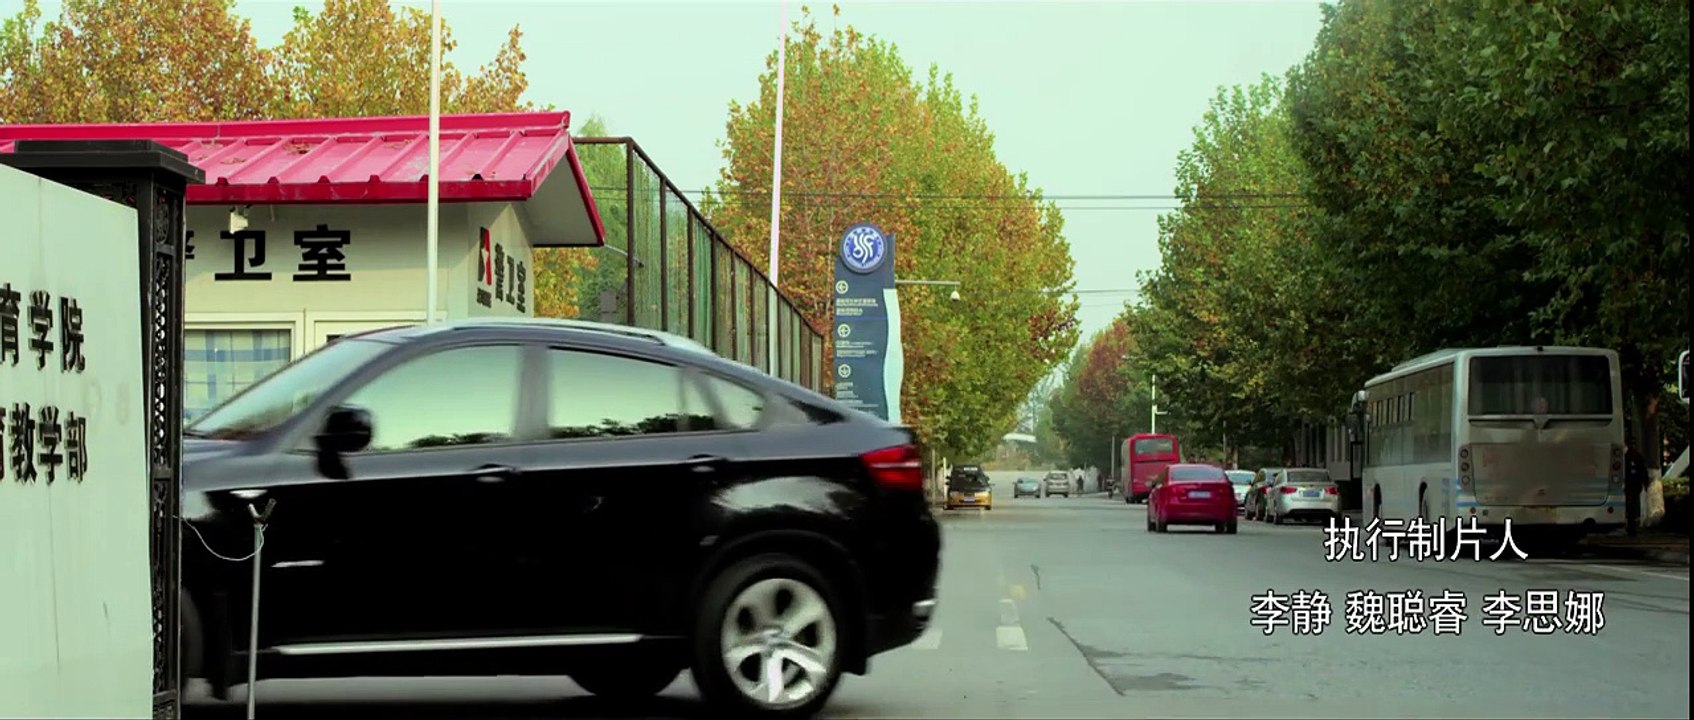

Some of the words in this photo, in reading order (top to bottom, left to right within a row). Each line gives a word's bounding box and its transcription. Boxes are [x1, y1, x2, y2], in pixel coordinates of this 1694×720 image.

[186, 224, 351, 281] 卫室
[0, 402, 88, 485] 教学部
